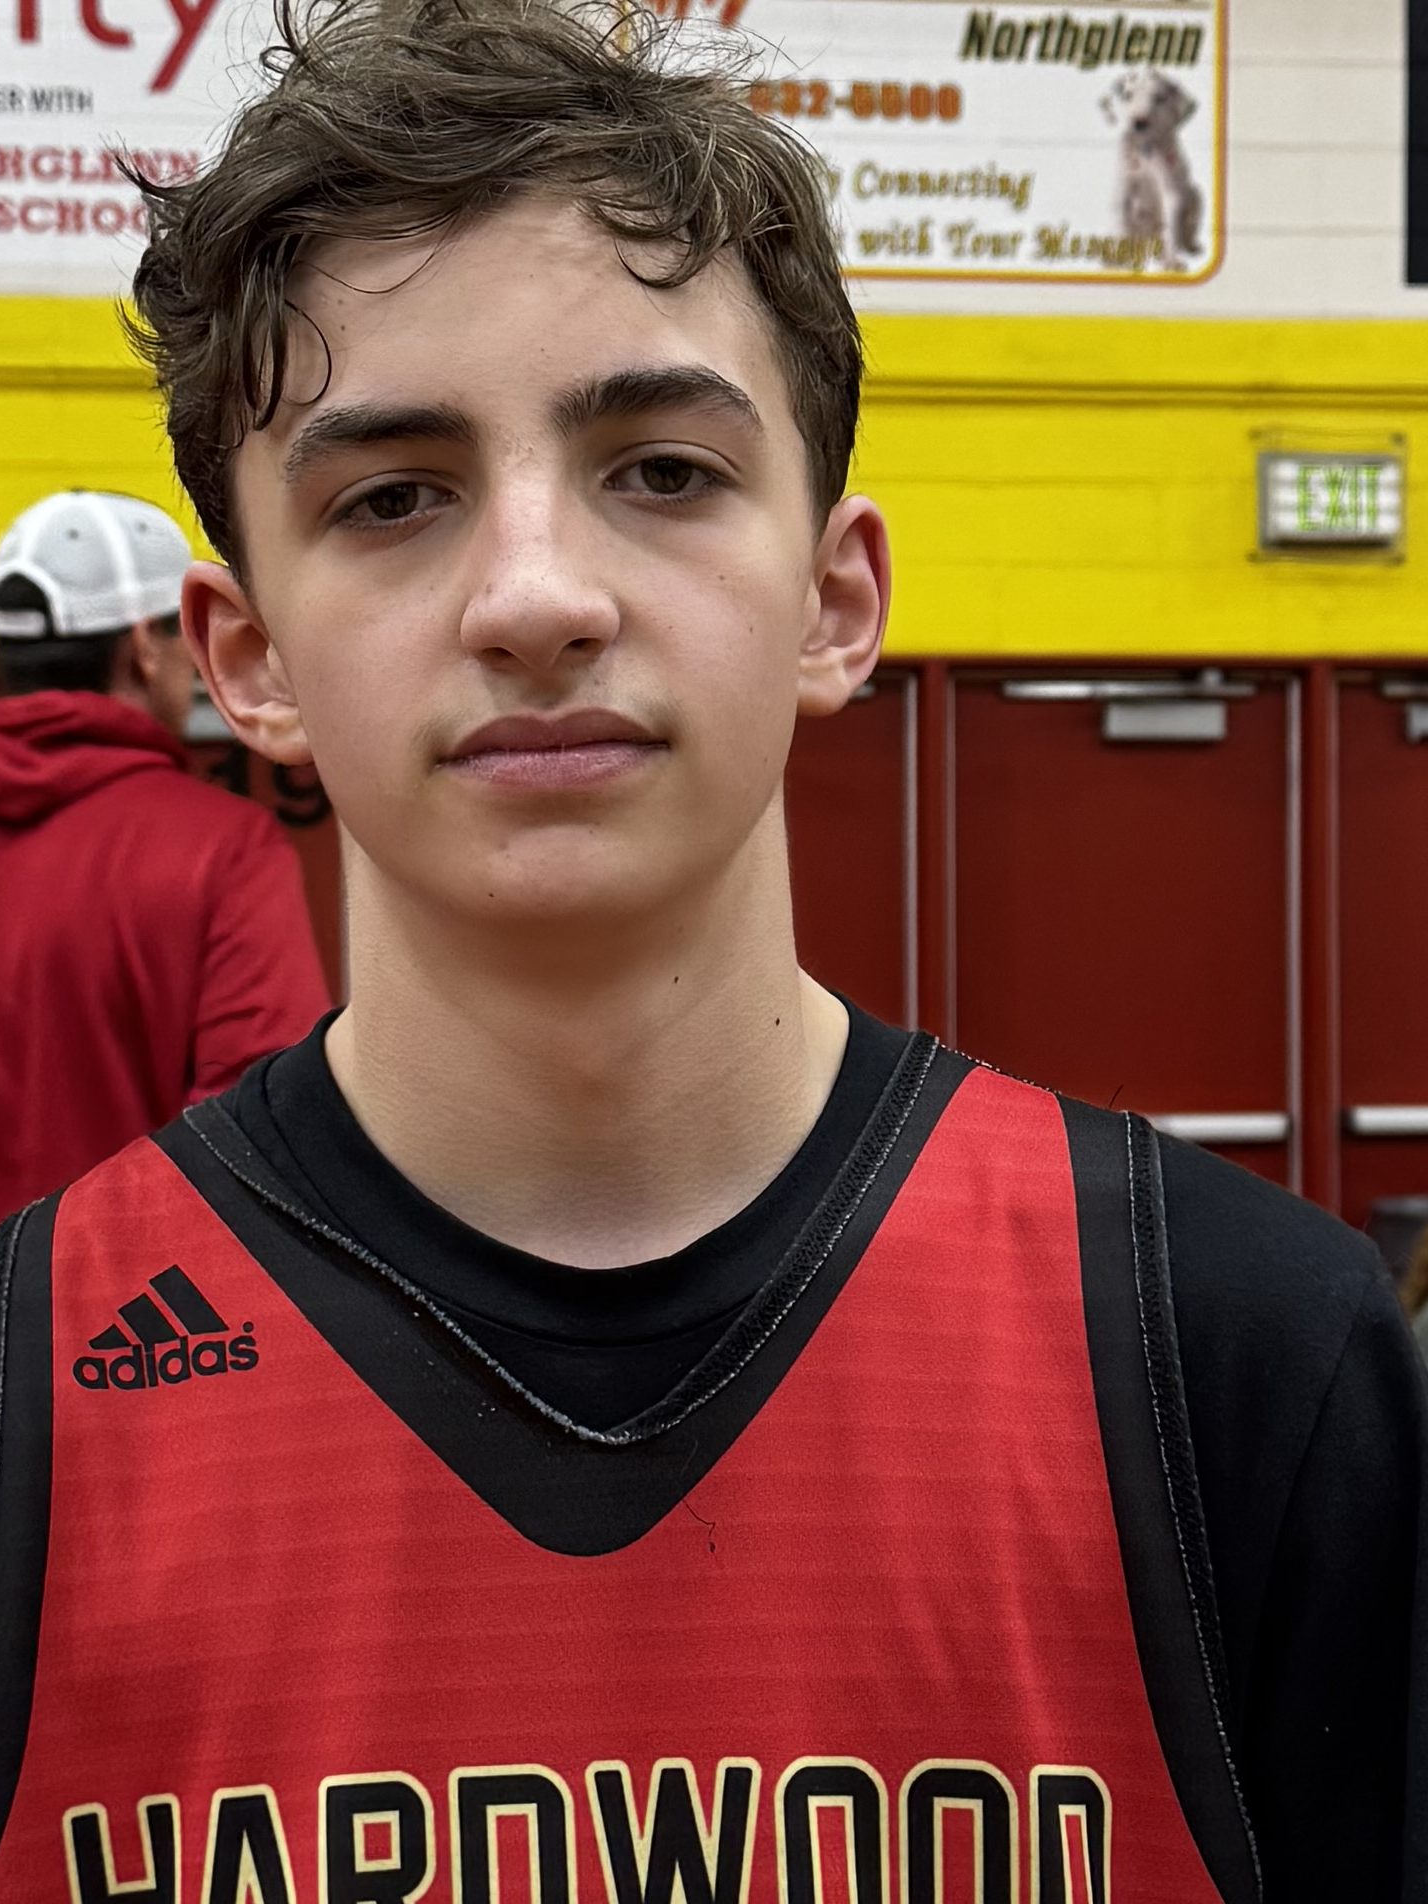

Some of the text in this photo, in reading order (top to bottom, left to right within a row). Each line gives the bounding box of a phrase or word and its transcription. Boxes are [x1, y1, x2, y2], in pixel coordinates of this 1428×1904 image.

[960, 11, 1202, 70] Northglenn
[32, 85, 93, 114] WITH
[1298, 464, 1382, 531] EXIT
[73, 1336, 259, 1390] adidas
